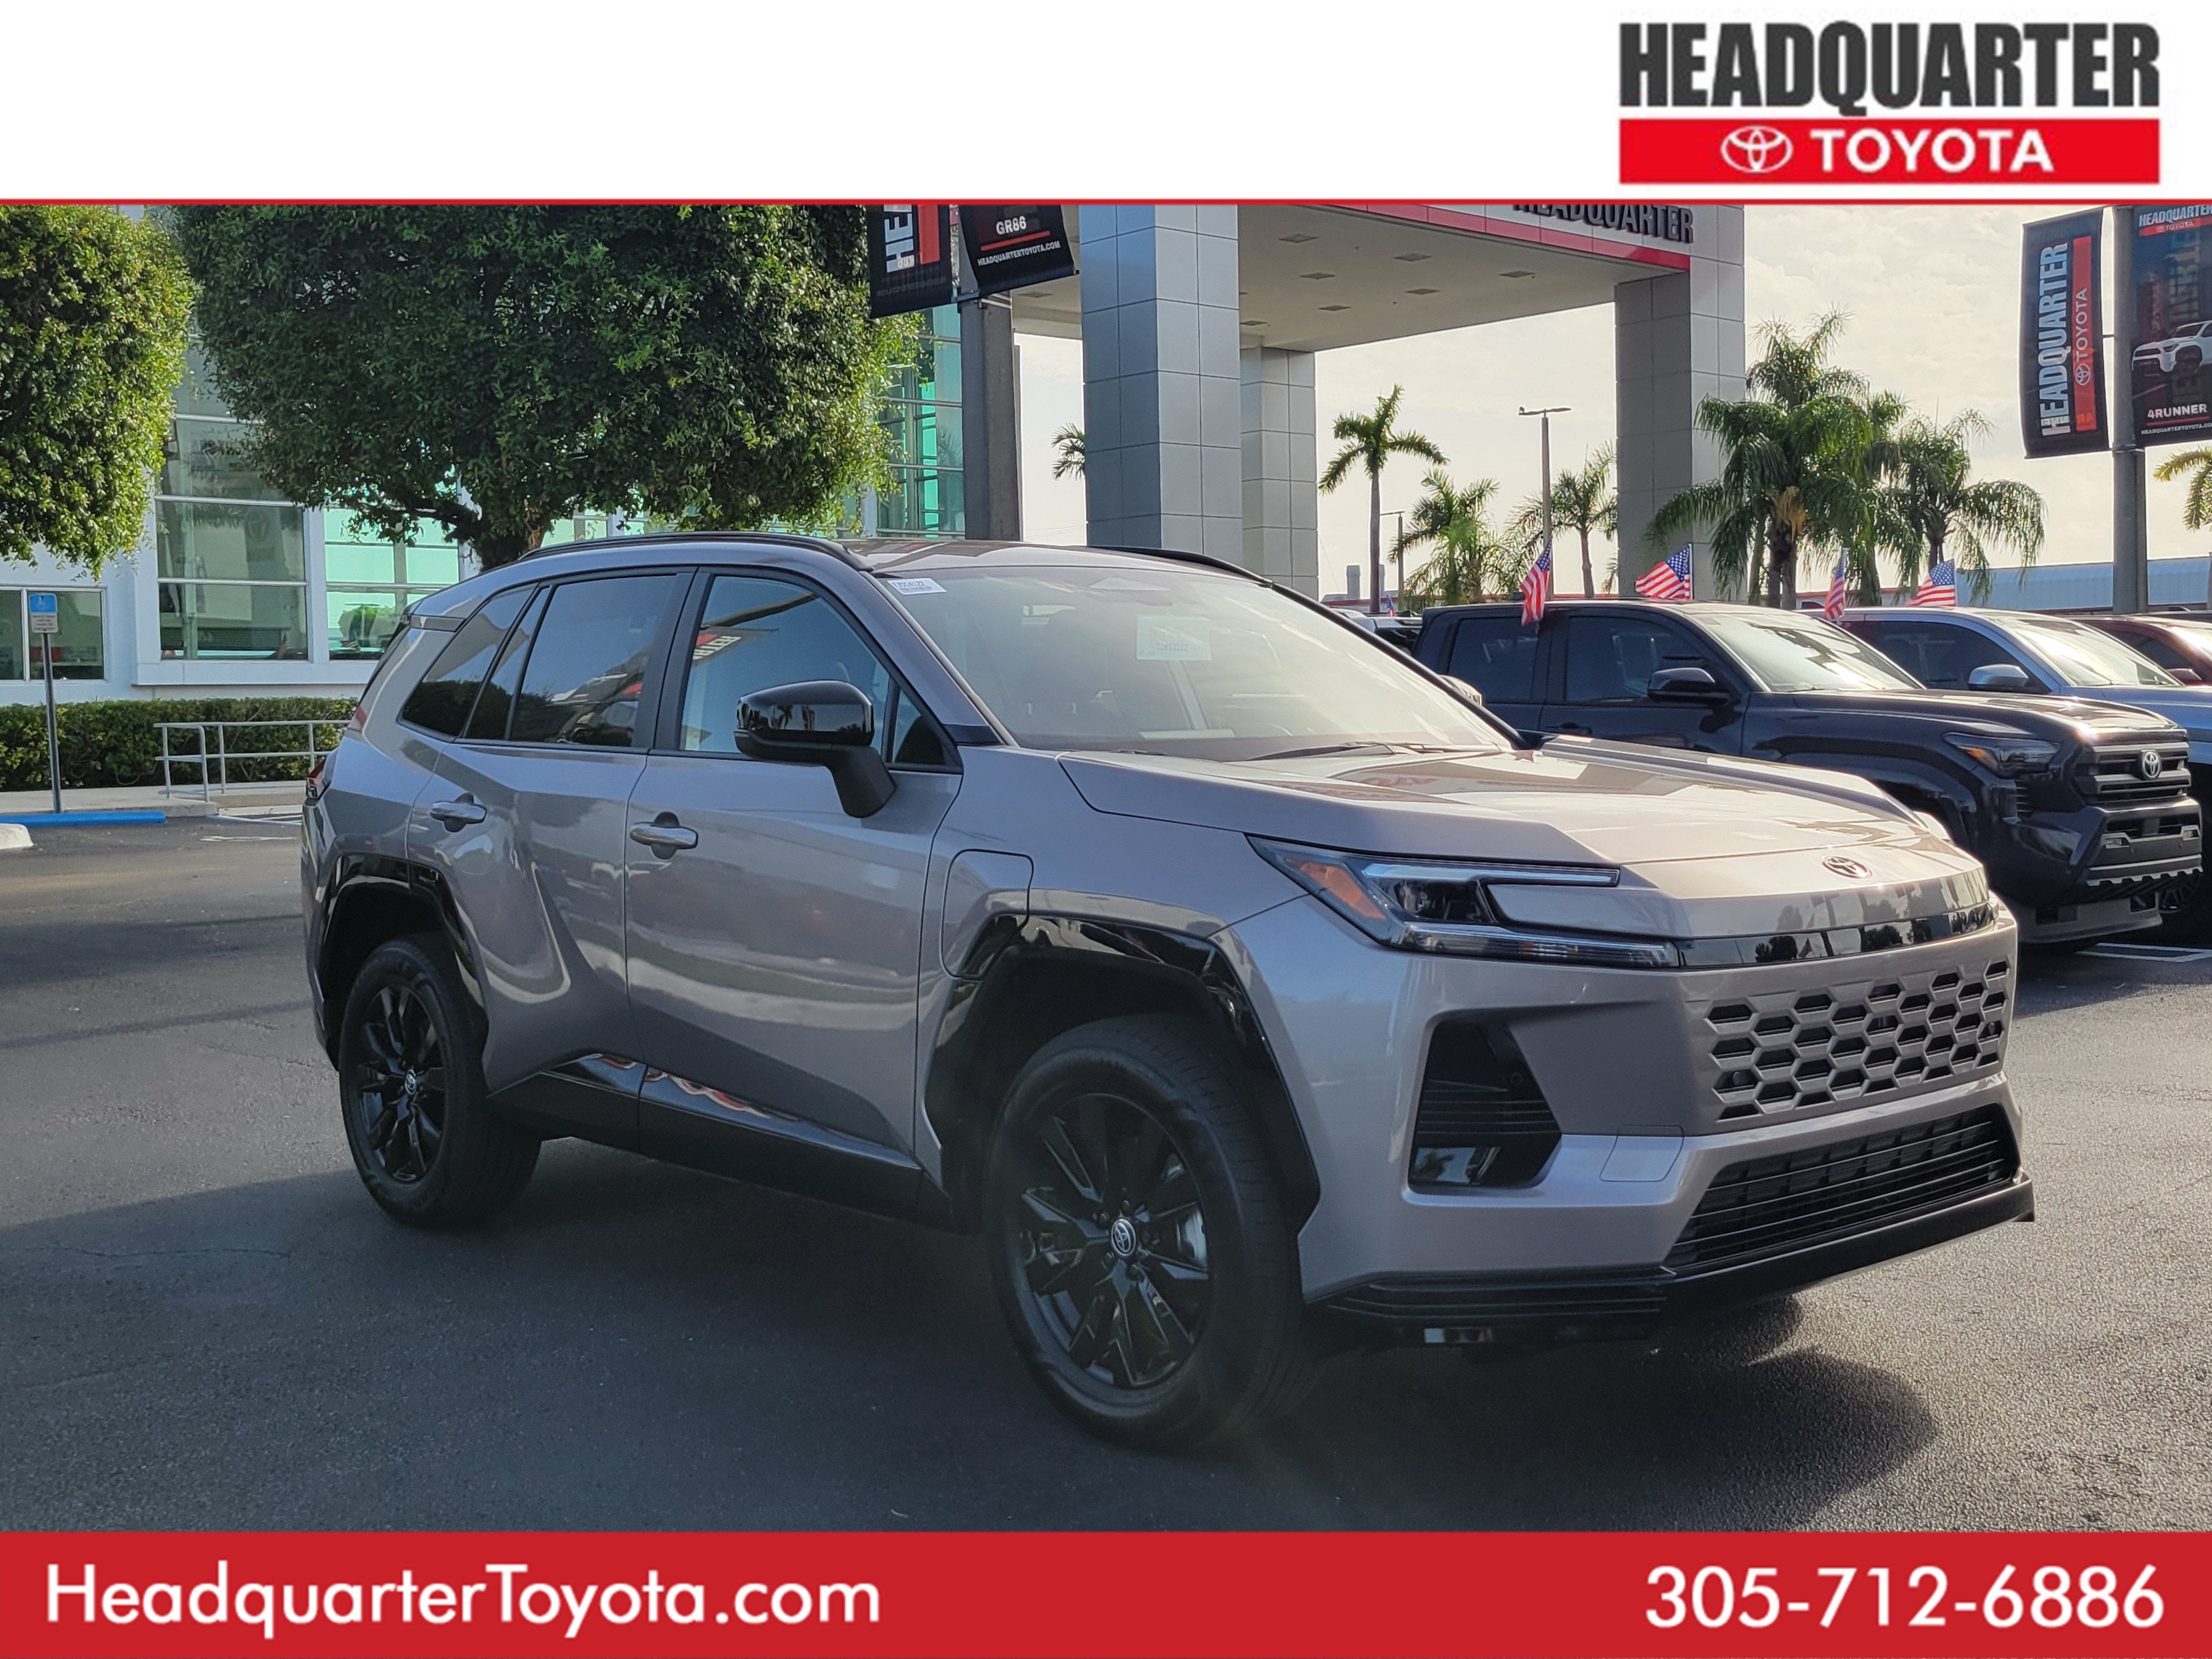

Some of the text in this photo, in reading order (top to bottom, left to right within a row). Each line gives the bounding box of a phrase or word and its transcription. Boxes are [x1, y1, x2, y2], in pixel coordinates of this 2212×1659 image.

[996, 216, 1027, 235] GR86
[1512, 204, 1694, 243] DQUARTER
[2165, 221, 2194, 231] TOYOTA
[883, 204, 915, 273] HE
[977, 240, 1061, 266] HEADQUARTERTOYOTA.COM
[2075, 287, 2088, 361] TOYOTA
[2038, 242, 2071, 436] HEADQUARTER
[2147, 404, 2208, 419] 4RUNNER
[2141, 422, 2212, 435] HEADQUARTERTOYOTA.CO
